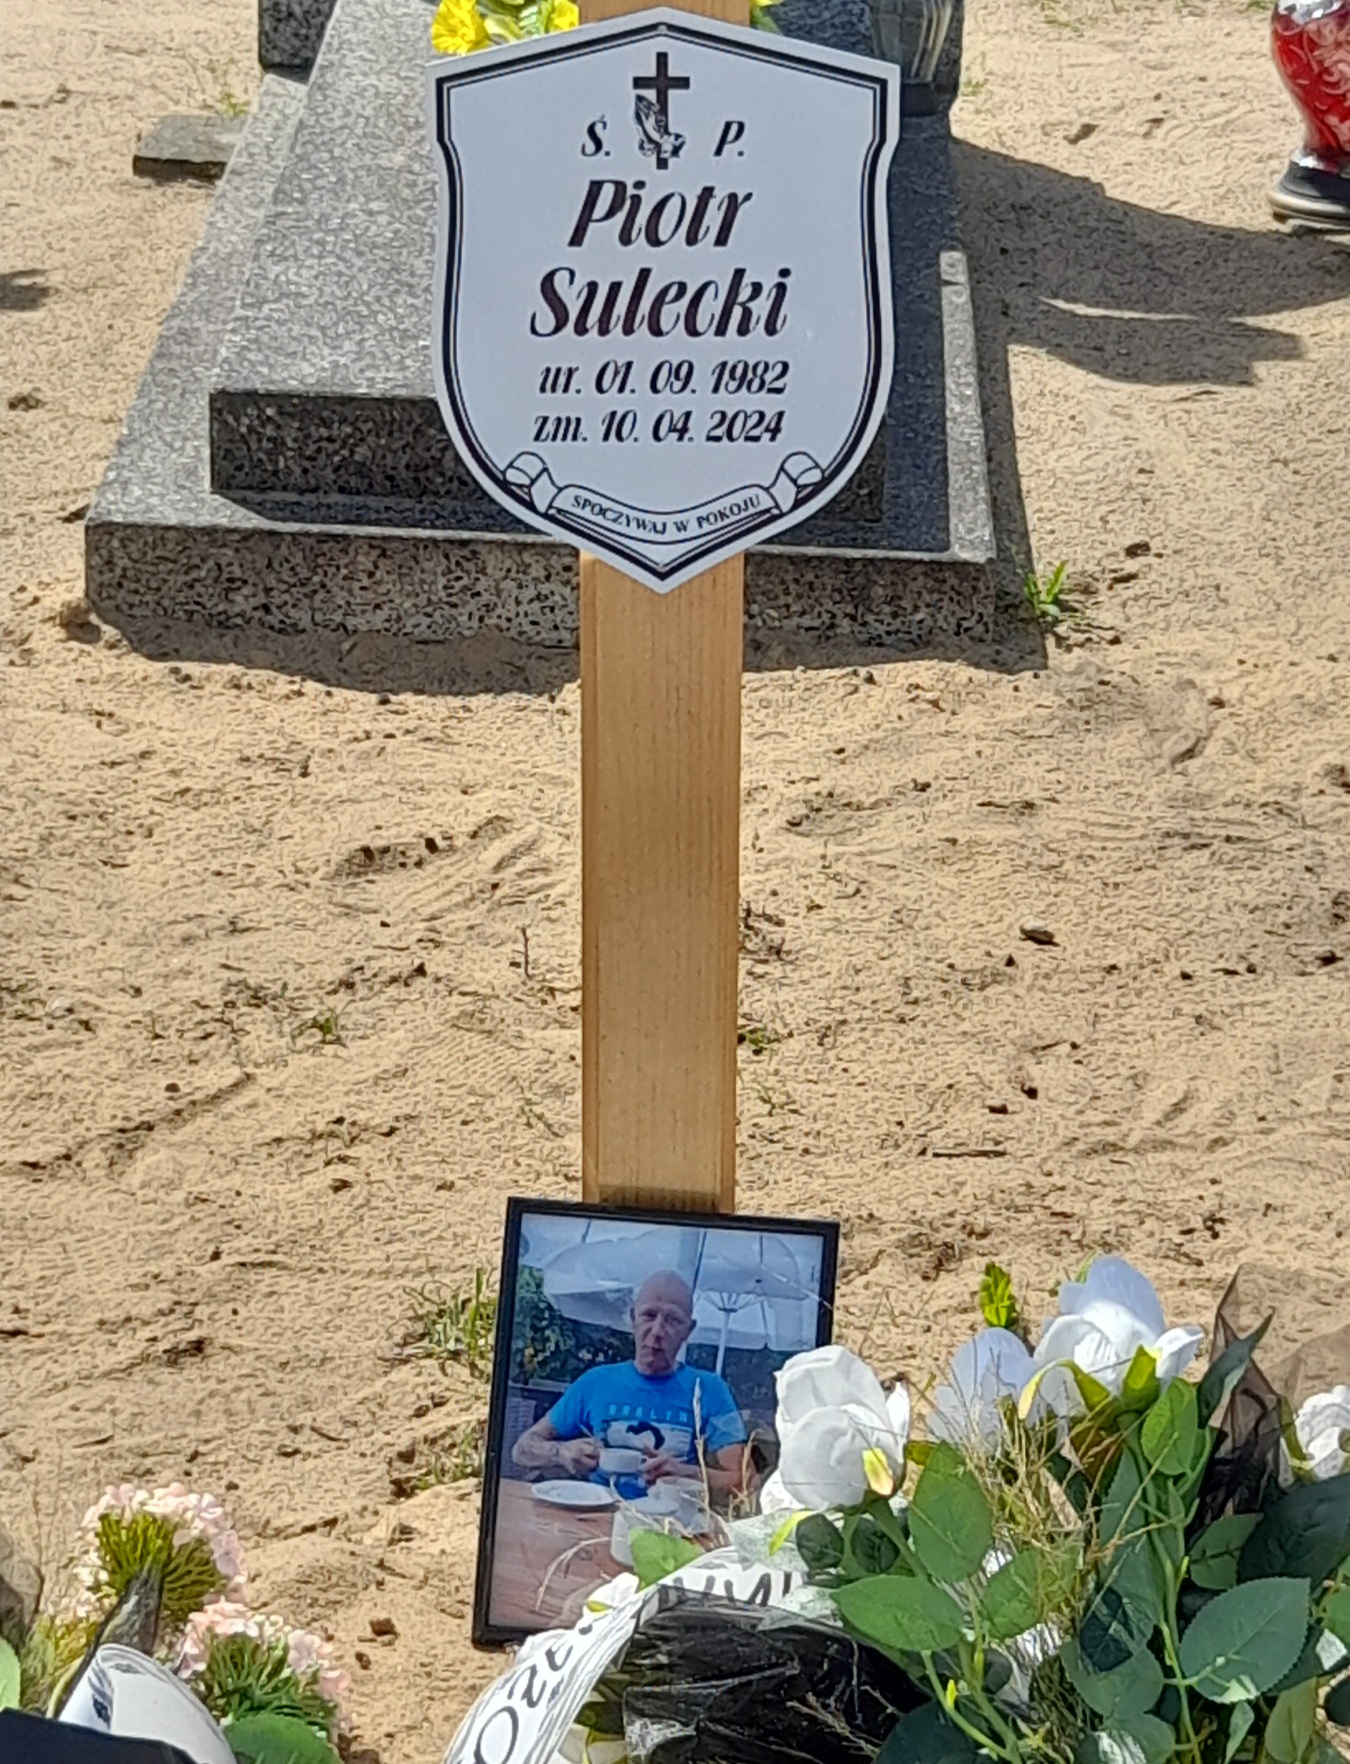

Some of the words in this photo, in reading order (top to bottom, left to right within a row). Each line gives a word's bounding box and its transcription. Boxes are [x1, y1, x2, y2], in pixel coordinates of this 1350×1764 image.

[580, 114, 611, 158] Ś.
[713, 120, 746, 158] P.
[566, 178, 754, 248] Piotr
[529, 266, 793, 338] Sulecki
[538, 365, 582, 395] ur.
[594, 359, 636, 395] 01.
[649, 359, 698, 395] 09.
[710, 359, 791, 395] 1982
[532, 414, 588, 443] zm.
[601, 409, 639, 443] 10.
[651, 409, 694, 443] 04.
[705, 409, 786, 443] 2024
[571, 493, 667, 536] SPOCZYWAJ
[673, 519, 690, 533] W
[696, 493, 762, 530] POKOJU
